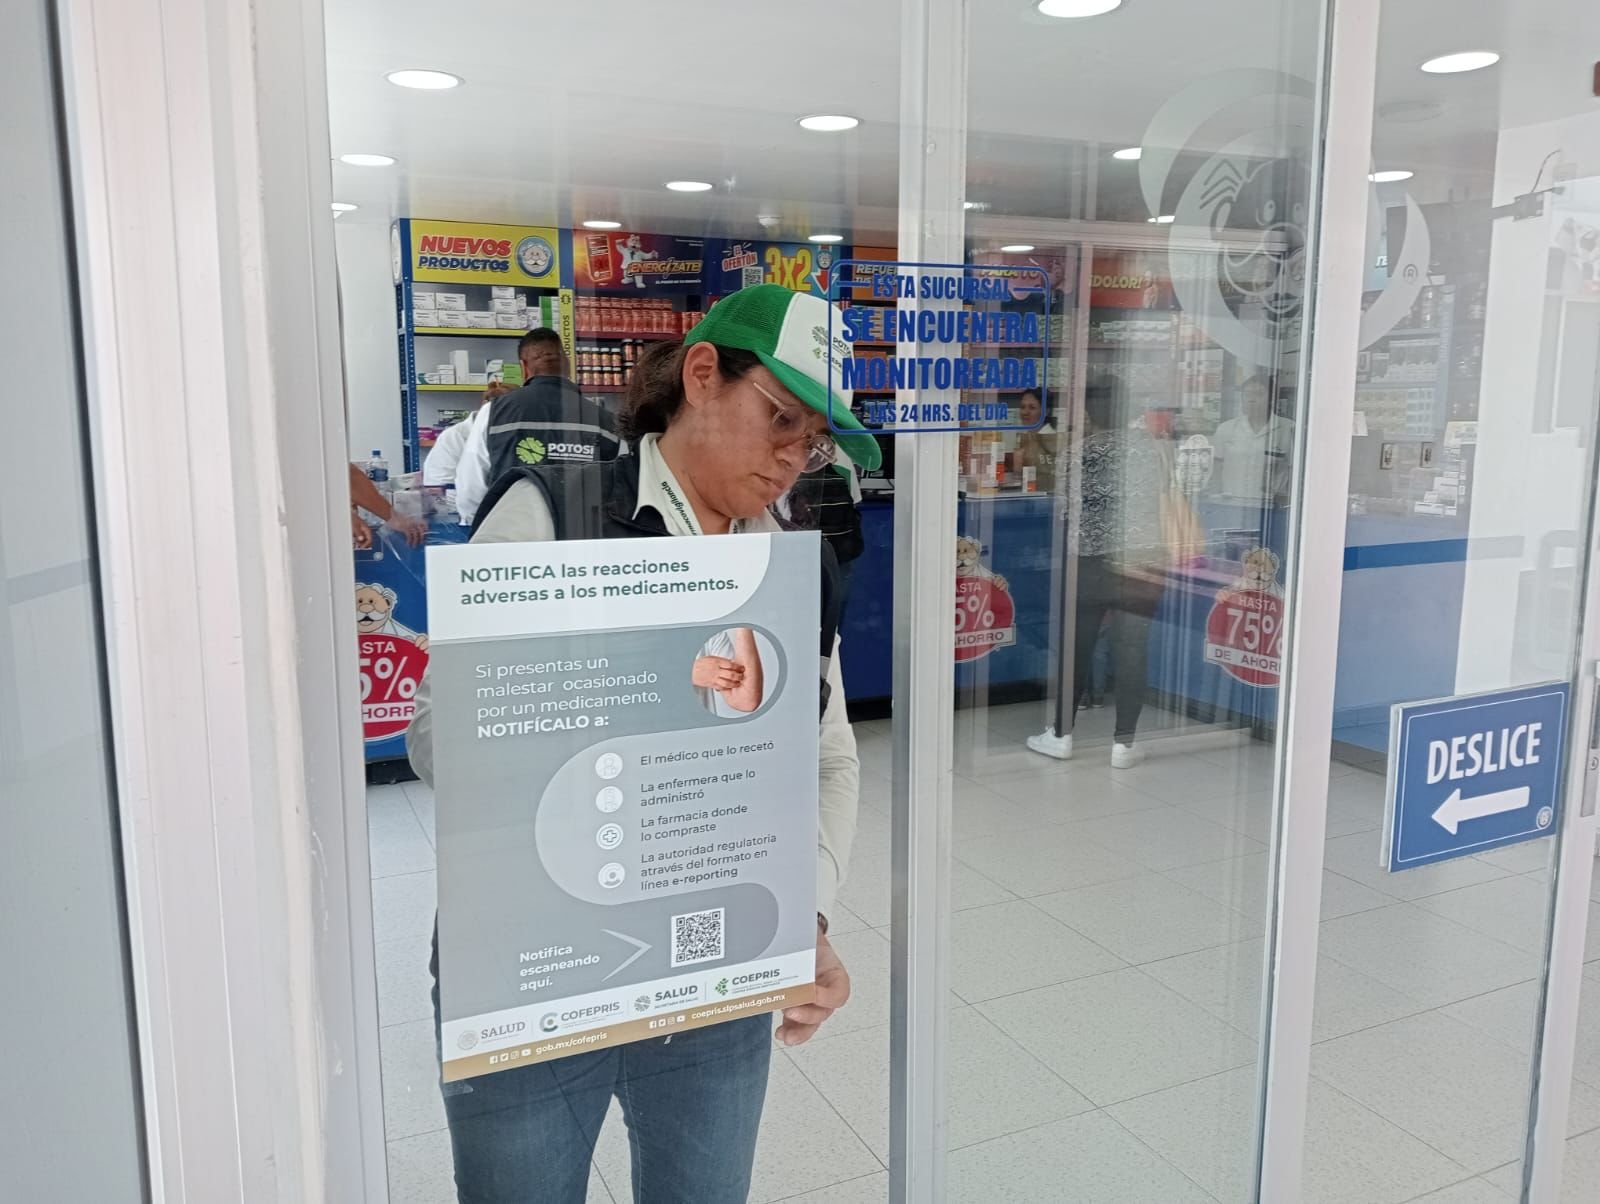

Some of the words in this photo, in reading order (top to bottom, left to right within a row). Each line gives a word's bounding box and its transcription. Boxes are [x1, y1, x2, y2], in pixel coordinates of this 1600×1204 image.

[419, 234, 513, 258] NUEVOS
[418, 256, 510, 273] PRODUCTOS
[856, 265, 897, 276] REFUE
[872, 274, 915, 298] ESTA
[920, 275, 1010, 301] SUCURSAL
[841, 308, 874, 343] SE
[883, 309, 1038, 343] ENCUENTRA
[842, 357, 1037, 390] MONITOREADA
[870, 403, 895, 423] LAS
[900, 404, 918, 422] 24
[922, 403, 954, 422] HRS.
[958, 403, 982, 421] DEL
[460, 565, 556, 584] NOTIFICA
[561, 563, 588, 579] las
[592, 559, 690, 577] reacciones
[460, 587, 549, 606] adversas
[553, 588, 565, 600] a
[570, 584, 597, 599] los
[602, 577, 739, 598] medicamentos.
[955, 582, 982, 594] STA
[1238, 595, 1277, 613] HASTA
[1226, 608, 1283, 654] 75%
[359, 641, 397, 654] STA
[475, 663, 492, 678] Si
[497, 658, 583, 680] presentas
[586, 657, 609, 670] un
[1214, 648, 1232, 661] DE
[1240, 654, 1281, 673] AHOR
[476, 680, 555, 699] malestar
[562, 670, 658, 691] ocasionado
[477, 704, 508, 722] por
[512, 702, 536, 715] un
[540, 692, 662, 714] medicamento,
[477, 715, 590, 739] NOTIFÍCALO
[594, 716, 609, 727] a:
[640, 755, 651, 765] El
[655, 751, 699, 764] médico
[701, 747, 723, 760] que
[726, 745, 737, 755] lo
[739, 740, 775, 753] recetó
[1426, 722, 1542, 785] DESLICE
[640, 783, 655, 793] La
[657, 776, 719, 791] enfermera
[721, 771, 744, 783] que
[746, 769, 756, 779] lo
[640, 789, 705, 807] administró
[640, 818, 655, 828] La
[657, 809, 709, 826] farmacia
[711, 804, 748, 818] donde
[640, 832, 652, 842] lo
[654, 823, 717, 840] compraste
[641, 853, 655, 864] La
[657, 843, 714, 861] autoridad
[717, 834, 777, 852] regulatoria
[640, 862, 684, 878] através
[686, 858, 704, 869] del
[706, 852, 752, 868] formato
[753, 849, 768, 859] en
[640, 879, 669, 891] línea
[672, 867, 738, 886] e-reporting
[519, 945, 573, 963] Notifica
[519, 954, 600, 977] escaneando
[519, 976, 553, 992] aquí.
[731, 968, 781, 986] COEPRIS
[654, 984, 699, 1002] SALUD
[560, 1001, 621, 1022] COFEPRIS
[480, 1021, 526, 1040] SALUD
[535, 1030, 608, 1056] gob.mx/cofepris
